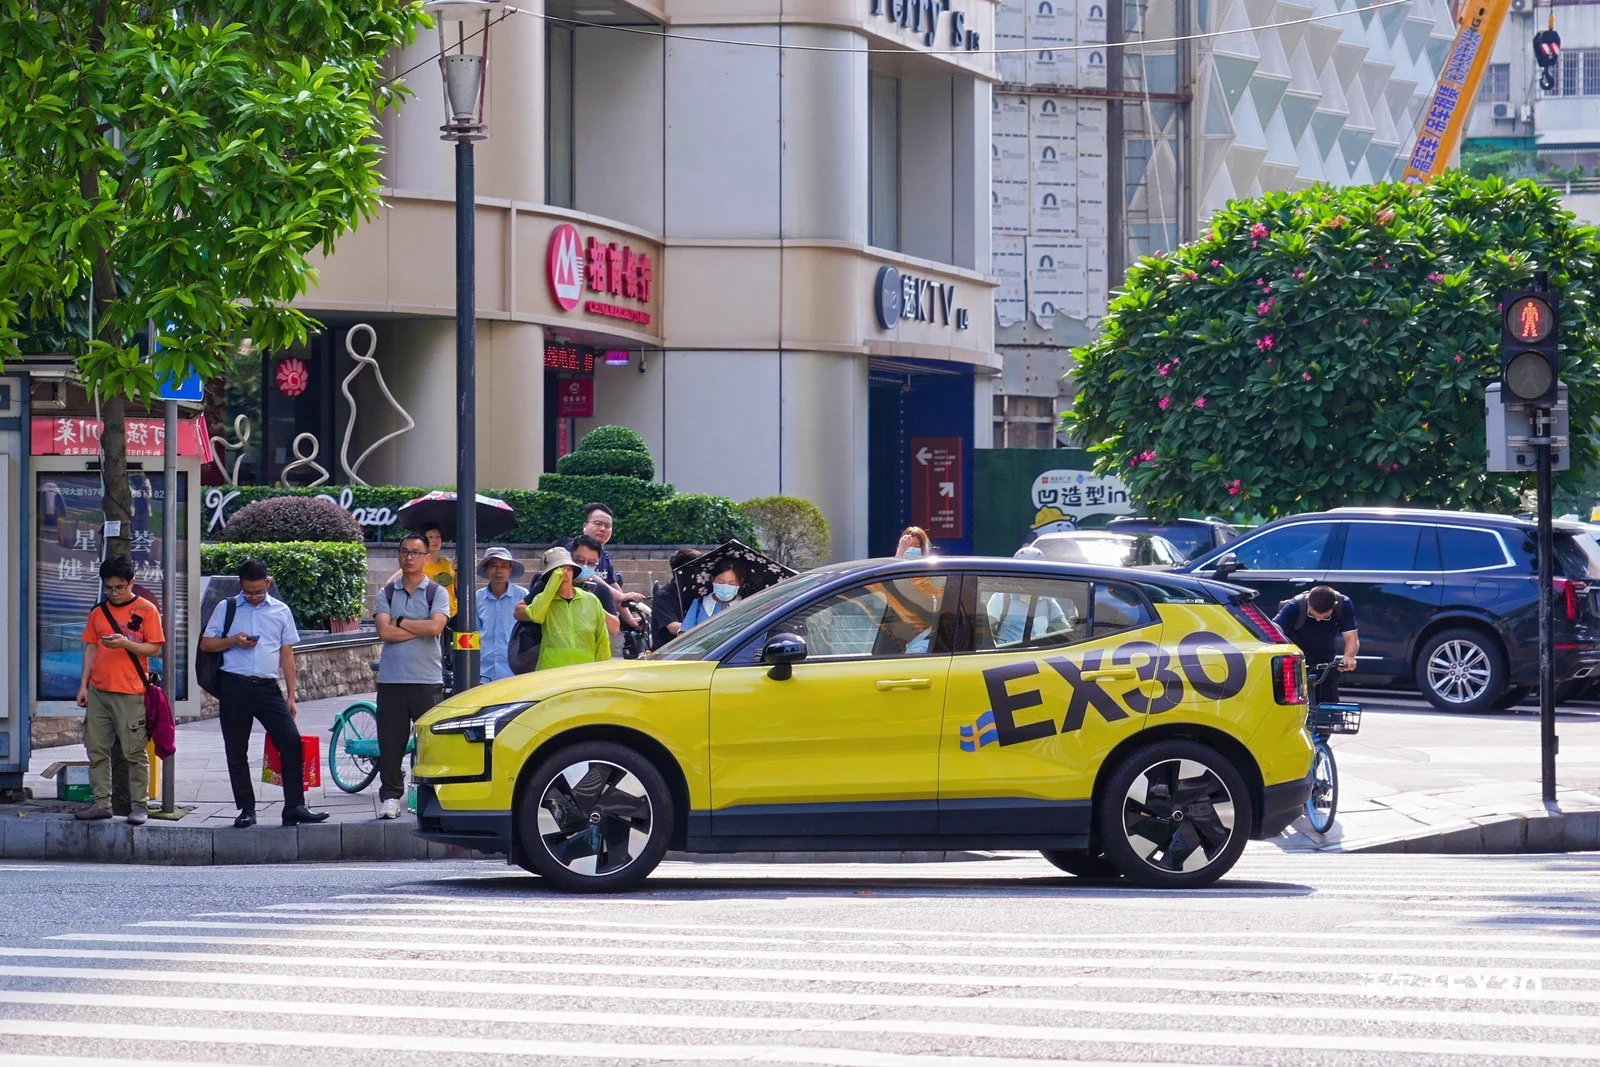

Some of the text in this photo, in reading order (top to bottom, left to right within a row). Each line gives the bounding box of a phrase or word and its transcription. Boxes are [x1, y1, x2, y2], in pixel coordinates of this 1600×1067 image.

[1410, 85, 1460, 173] 高空车/吊车租赁
[72, 529, 155, 553] 星荟
[982, 631, 1247, 747] EX30
